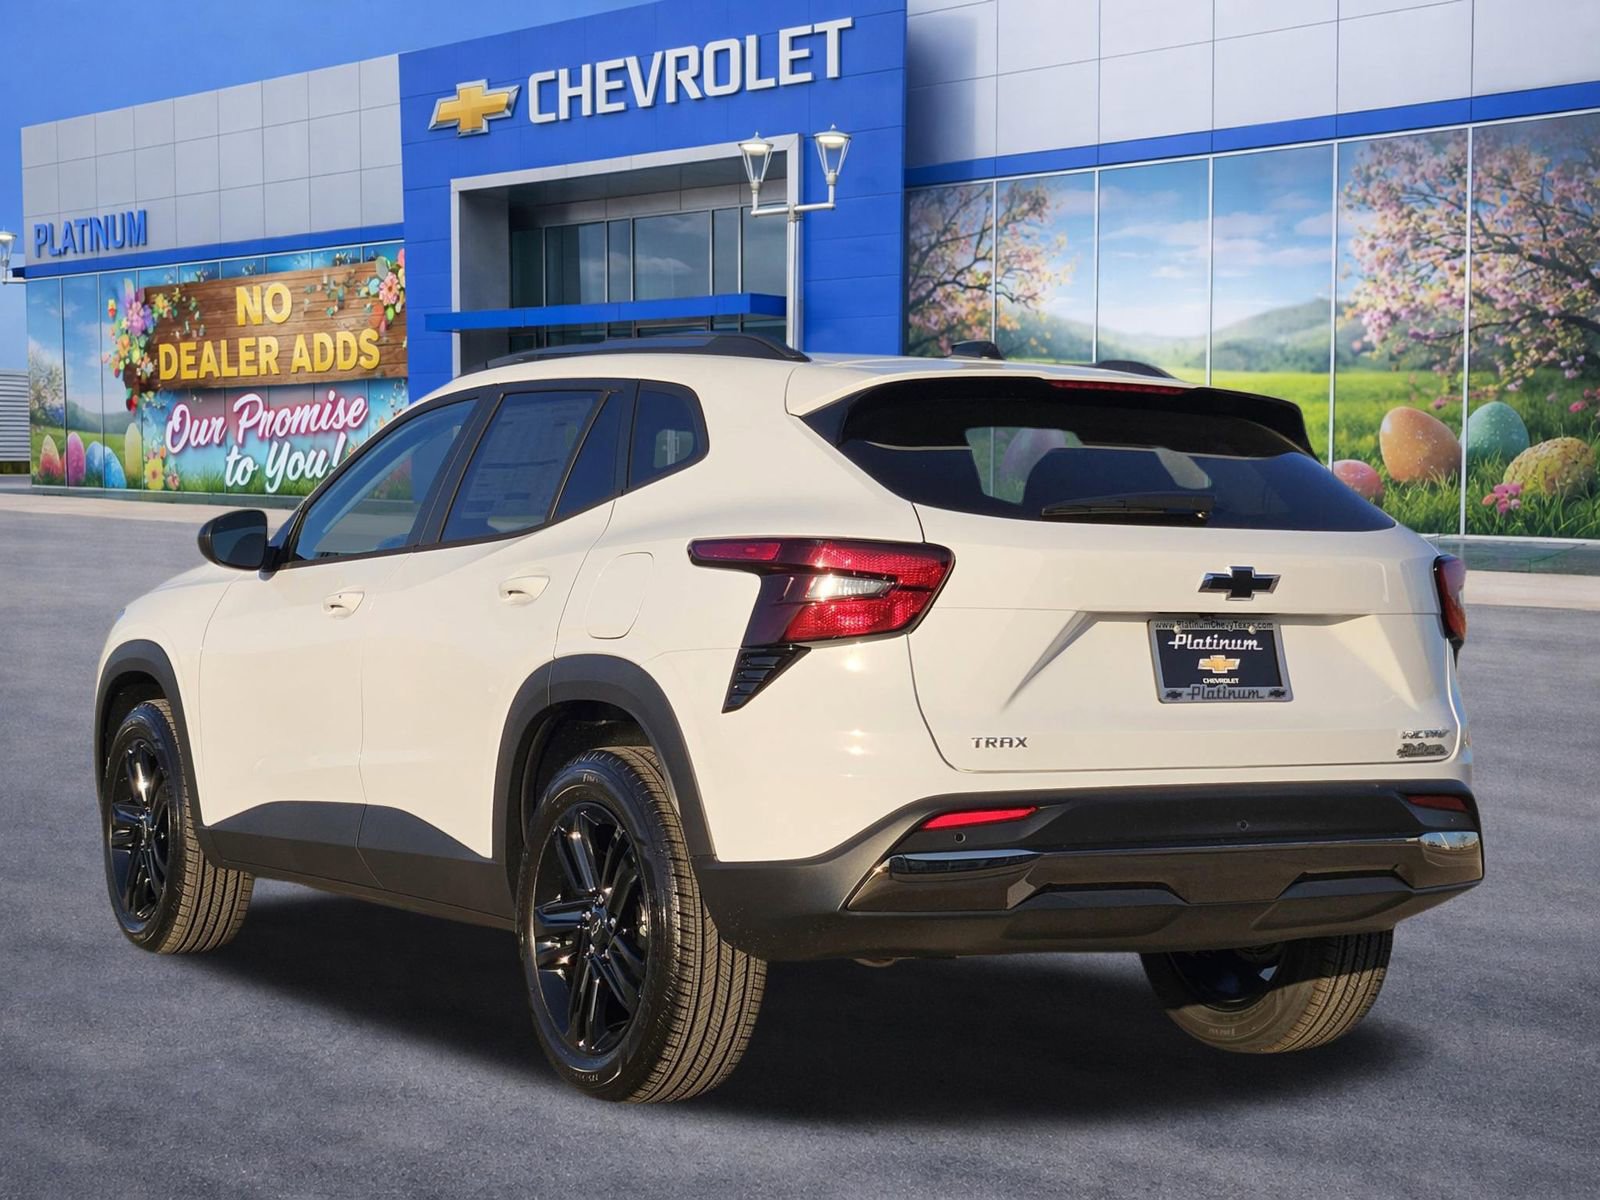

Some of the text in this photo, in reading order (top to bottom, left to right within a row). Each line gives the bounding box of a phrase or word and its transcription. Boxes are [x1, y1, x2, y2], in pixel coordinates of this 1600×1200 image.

[528, 16, 854, 125] CHEVROLET
[34, 209, 148, 258] PLATINUM
[235, 281, 293, 327] NO
[158, 329, 381, 380] DEALER ADDS
[165, 390, 368, 455] Our Promise
[225, 432, 347, 494] to You!
[1168, 633, 1263, 651] Platinum
[1187, 685, 1265, 701] Platinum
[1202, 677, 1239, 685] CHEVROLET
[971, 736, 1028, 749] TRAX
